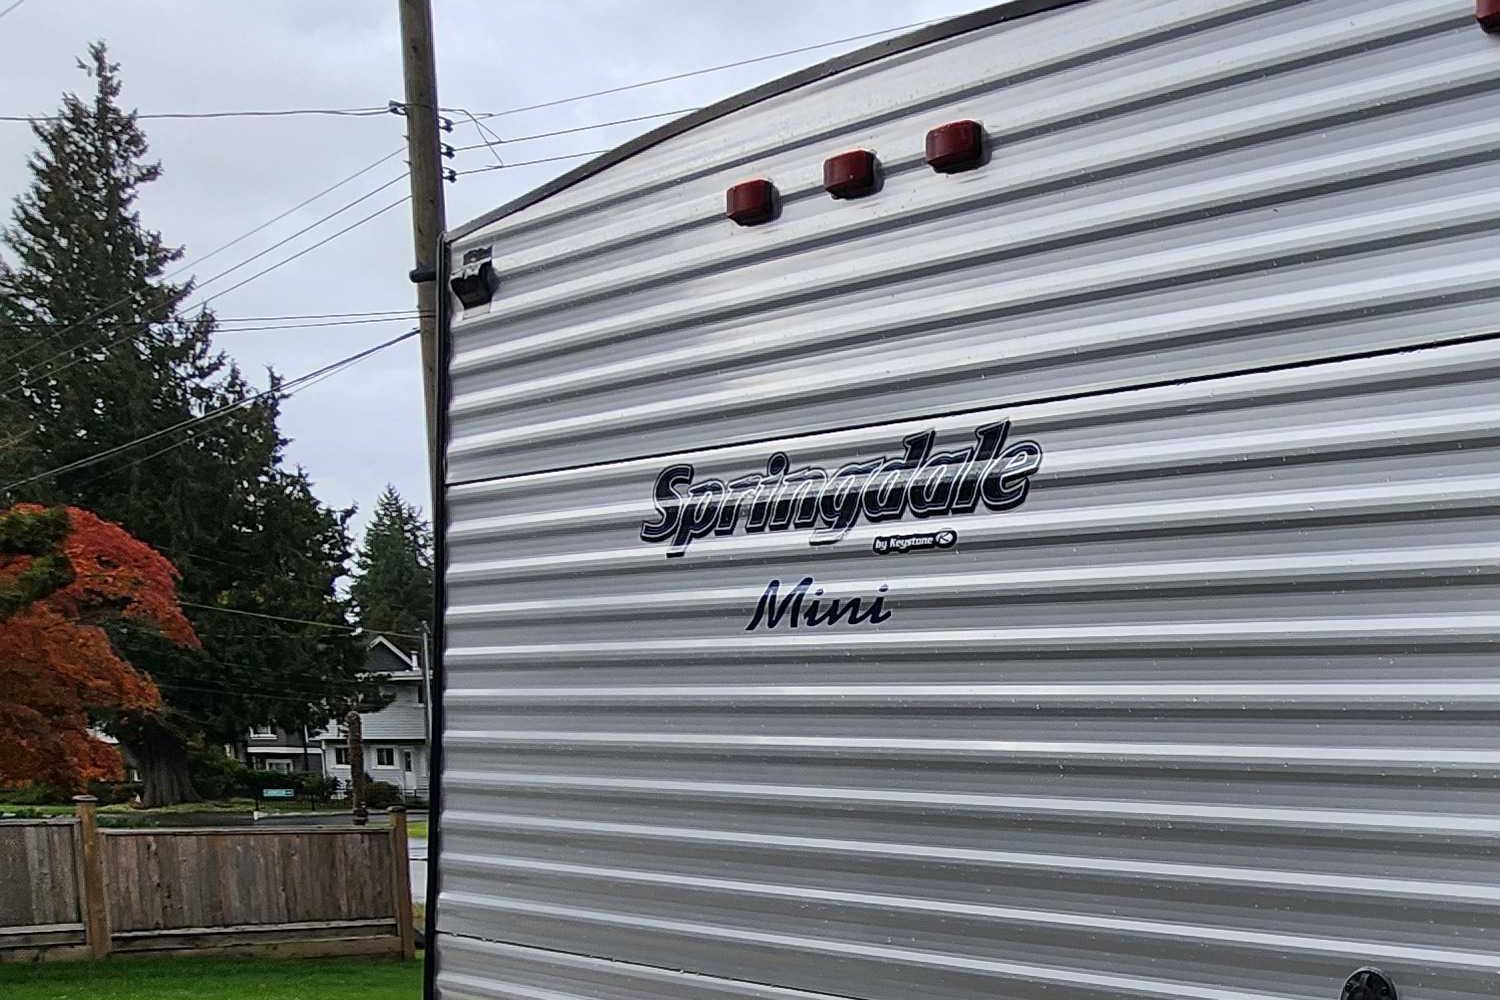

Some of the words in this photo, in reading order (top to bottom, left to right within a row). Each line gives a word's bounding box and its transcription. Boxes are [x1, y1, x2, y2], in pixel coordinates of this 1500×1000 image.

[640, 418, 1043, 558] Springdale
[889, 536, 933, 549] Keystone
[744, 575, 892, 631] Mini
